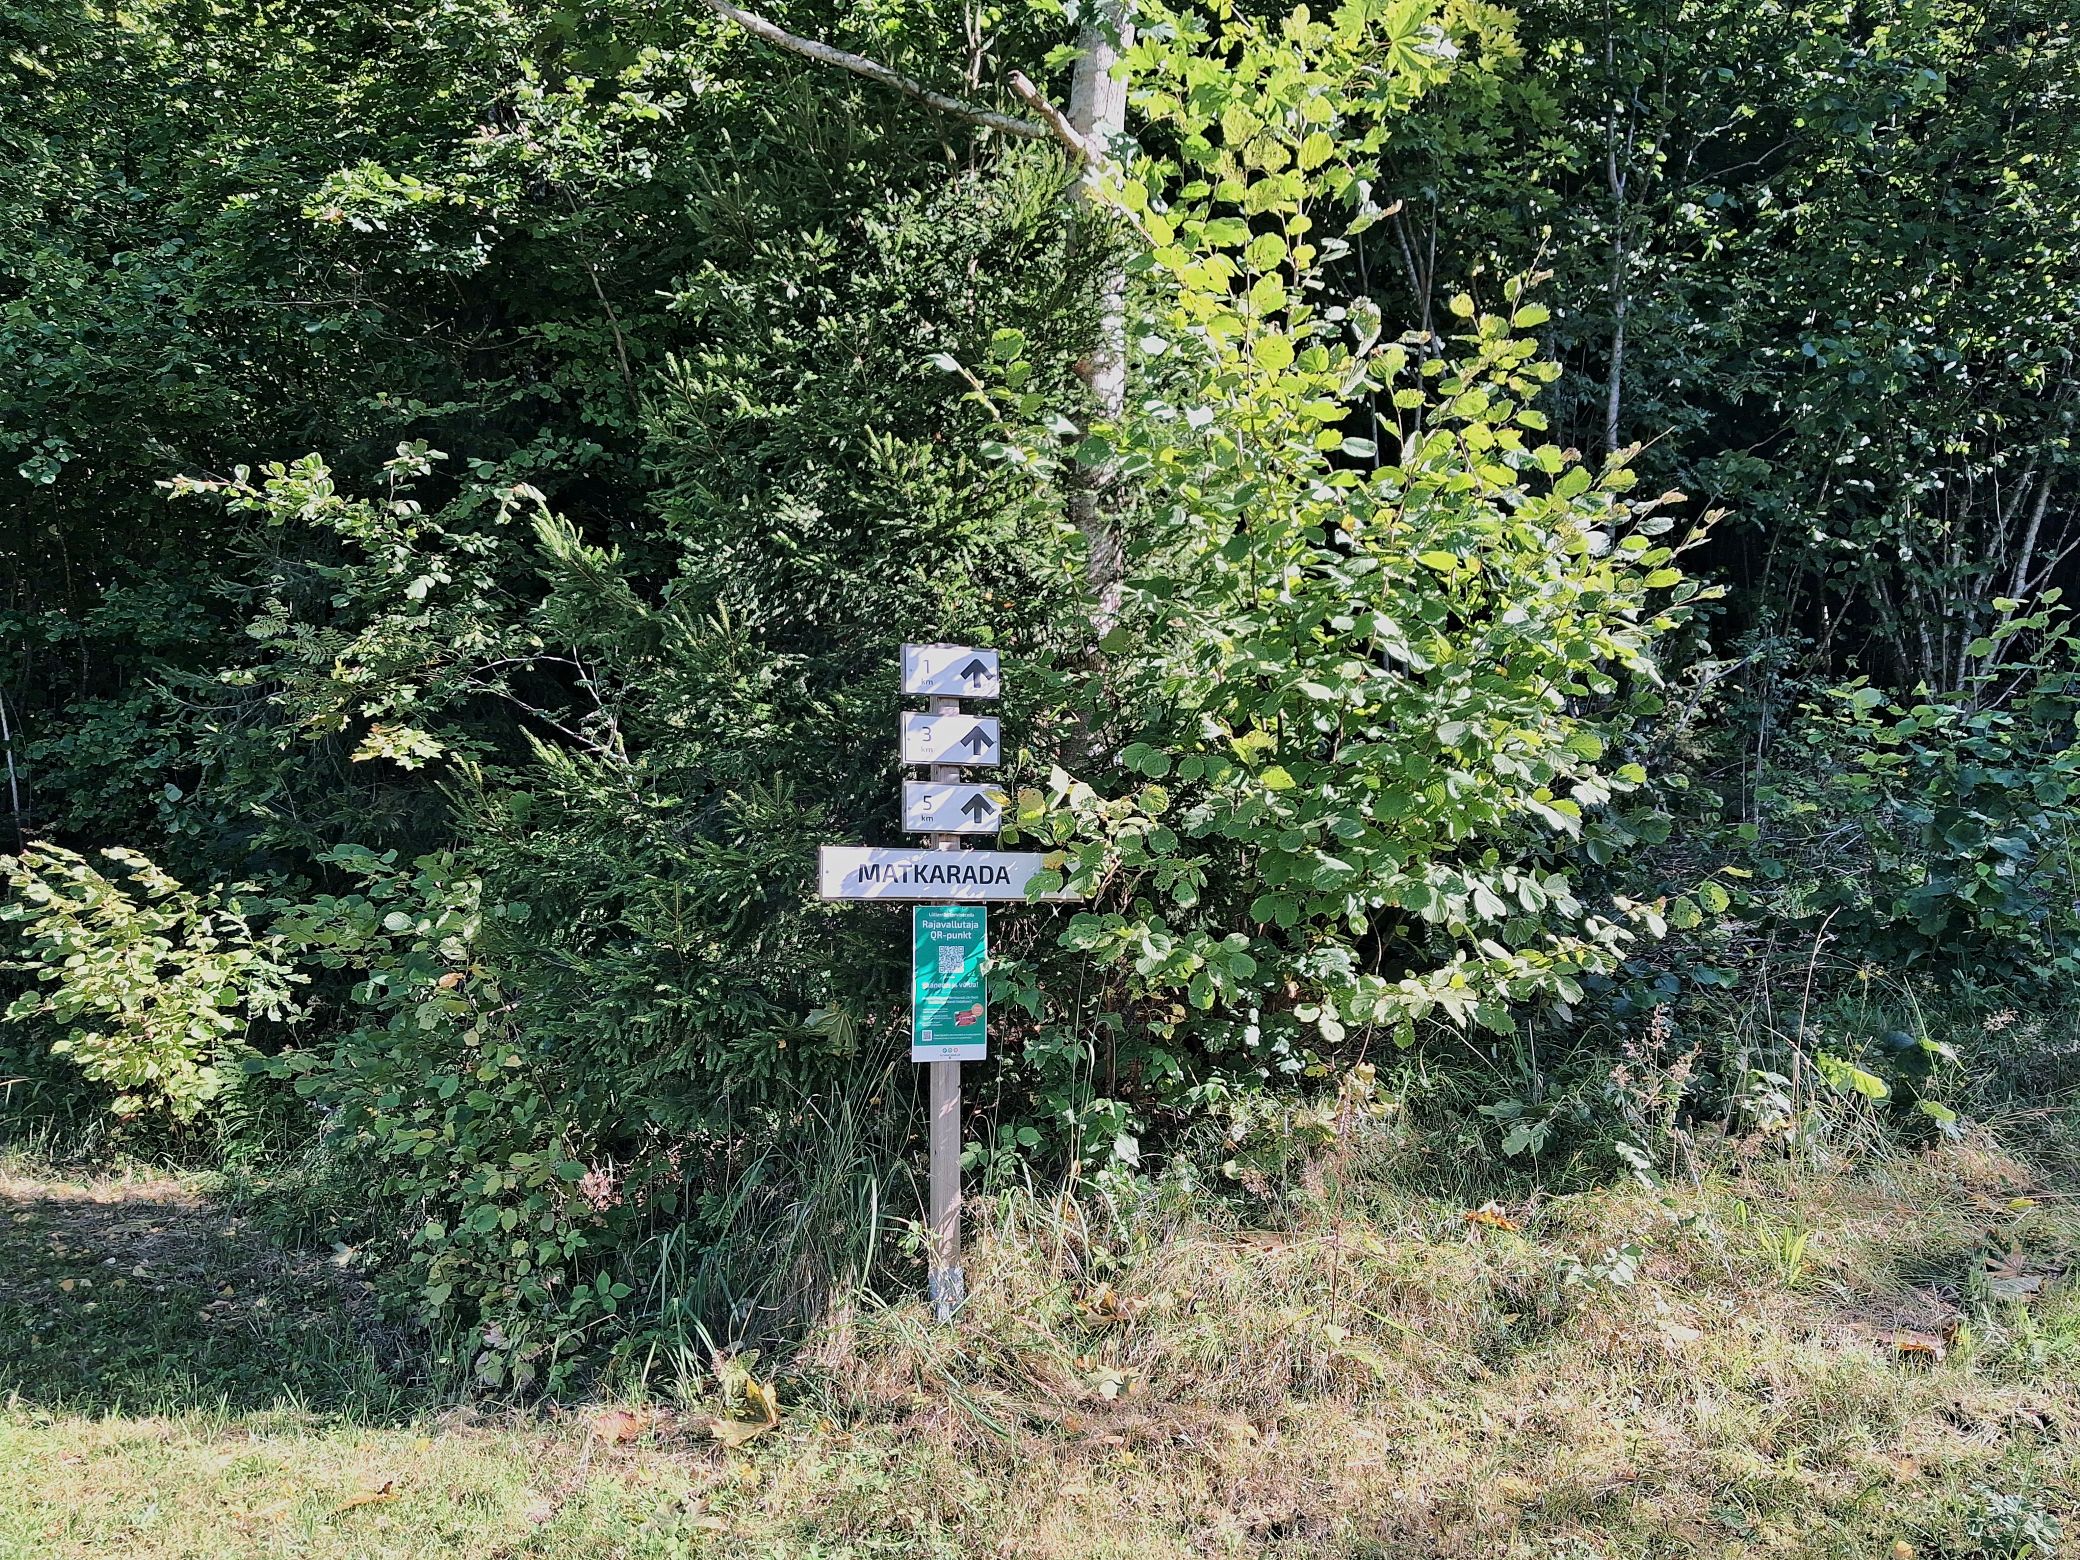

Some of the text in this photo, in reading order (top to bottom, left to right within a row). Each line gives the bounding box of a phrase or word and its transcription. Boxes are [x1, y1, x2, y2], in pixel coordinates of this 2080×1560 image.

[923, 659, 930, 674] 1
[921, 678, 934, 686] km
[922, 726, 932, 742] 3
[922, 795, 933, 811] 5
[921, 815, 934, 823] km
[858, 863, 1011, 885] MATKARADA
[922, 919, 979, 930] Rajavallutaja
[930, 931, 972, 941] QR-punkt
